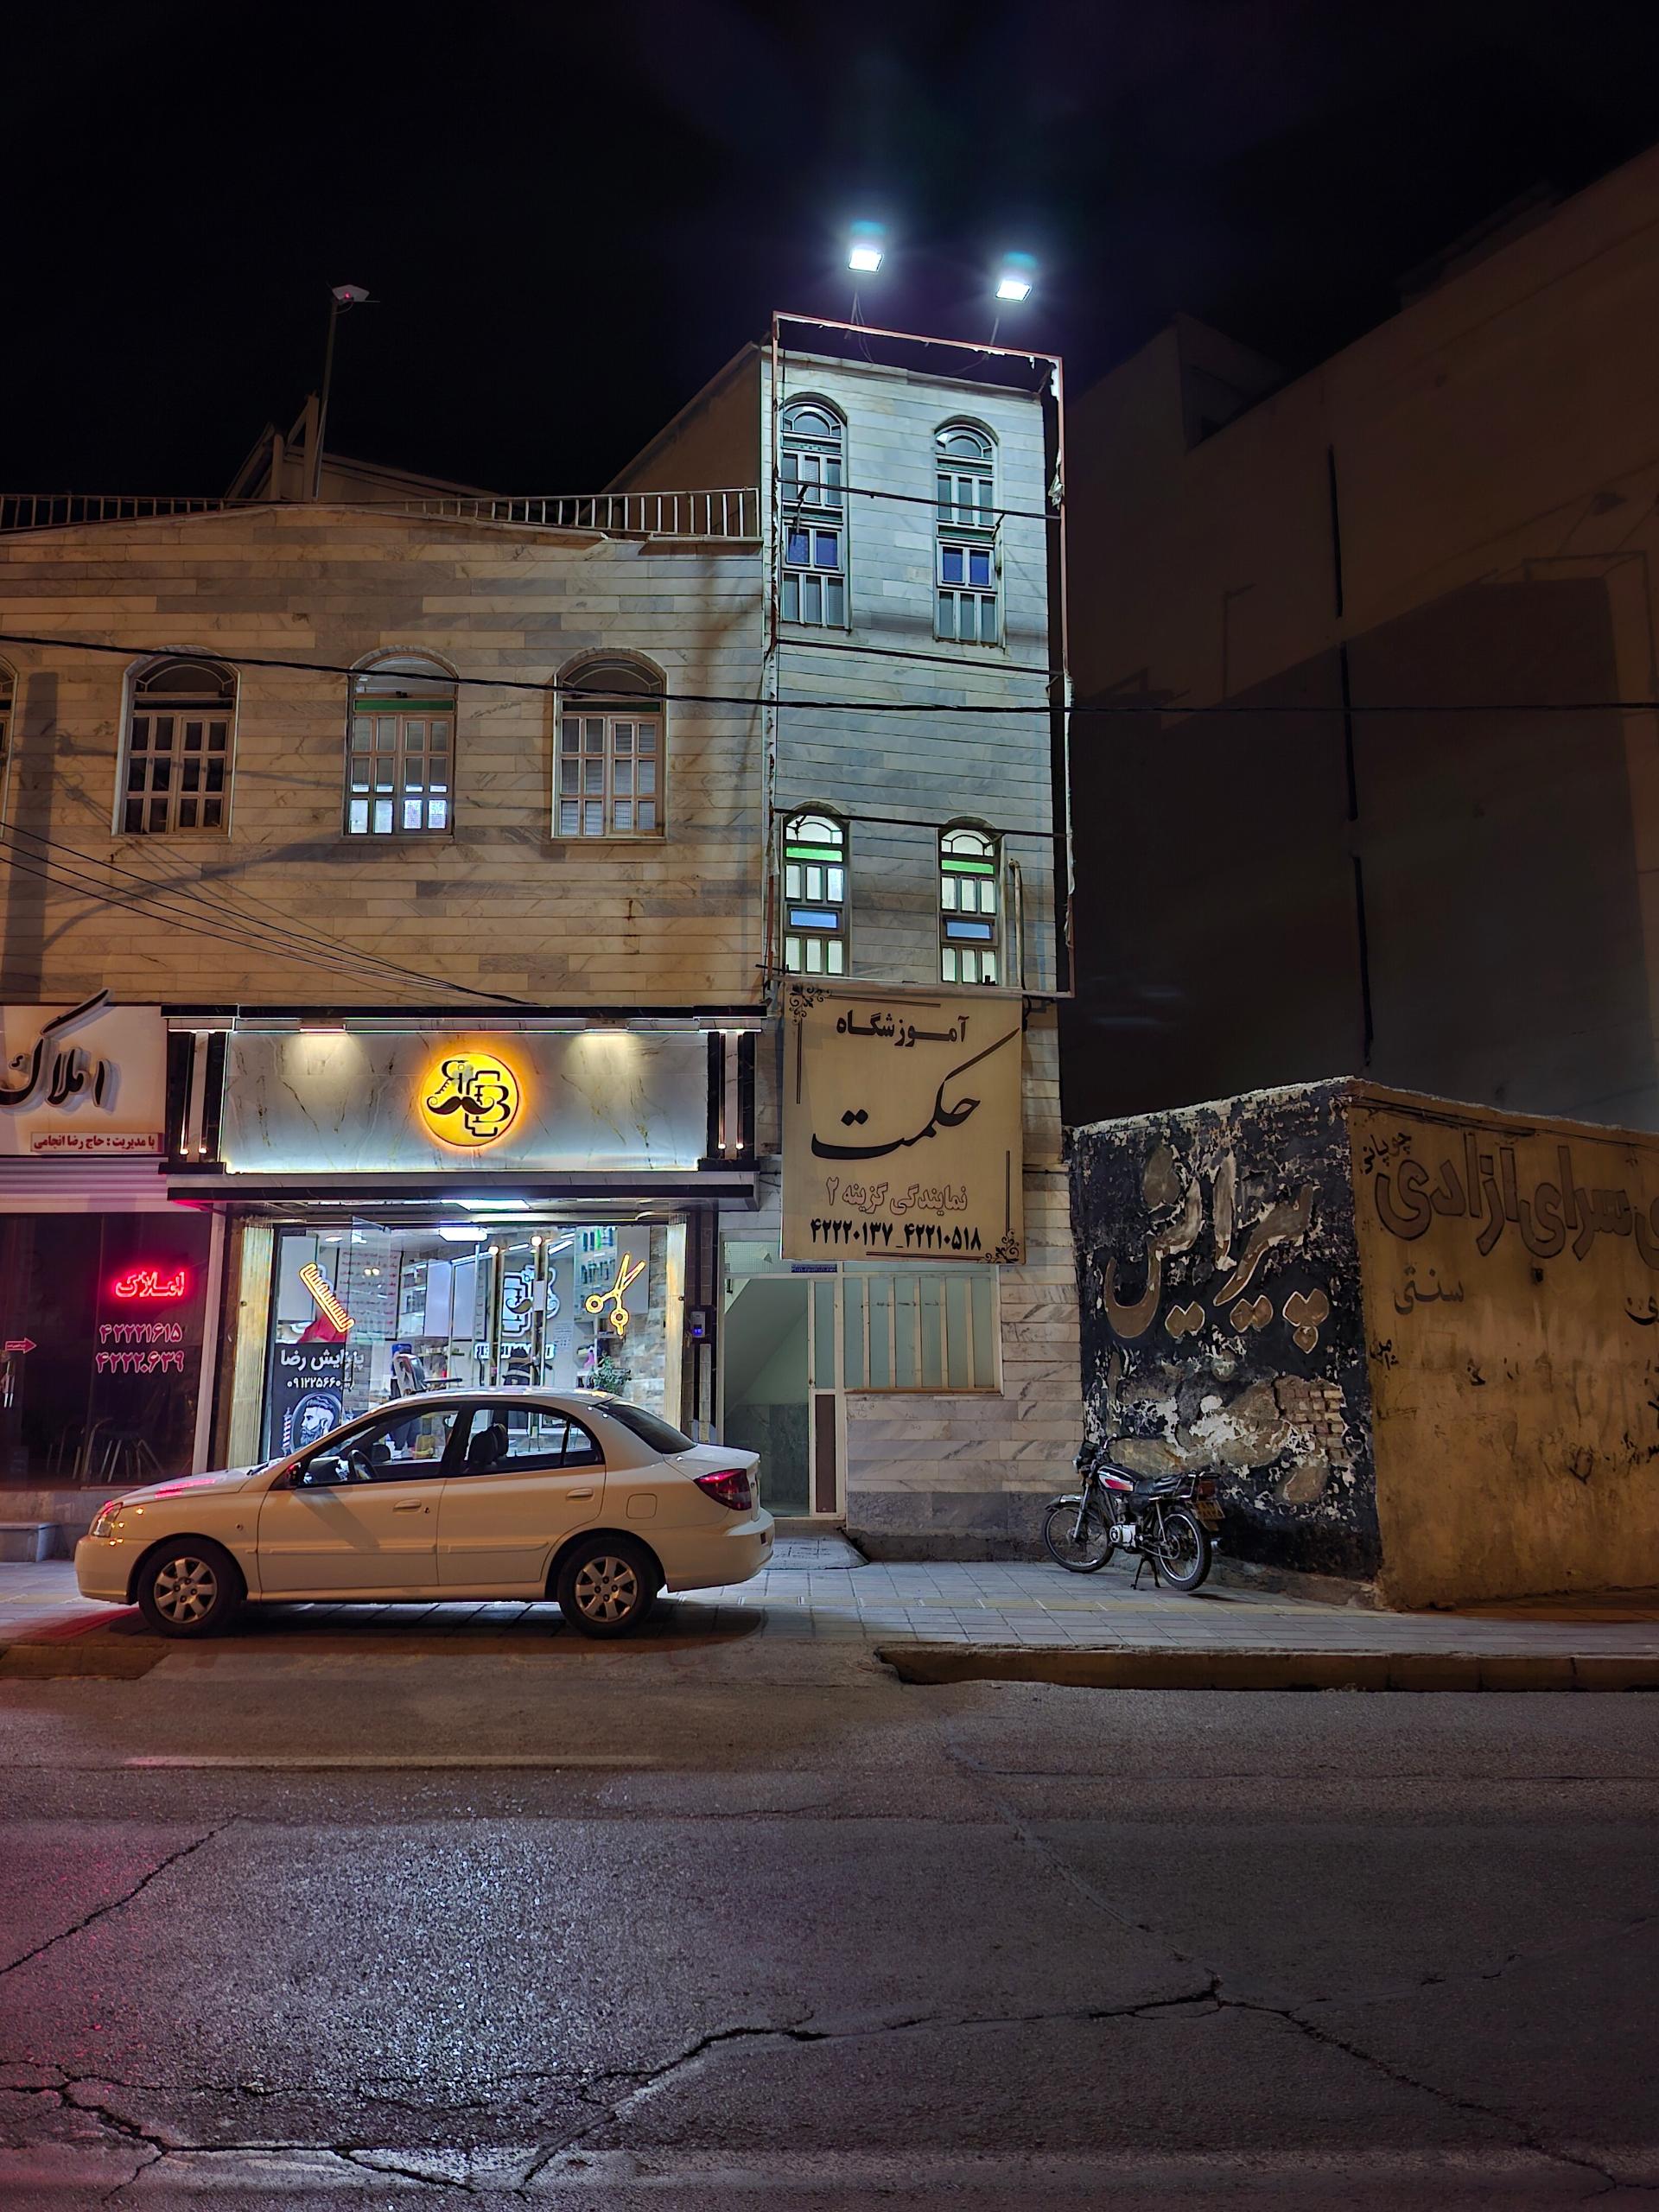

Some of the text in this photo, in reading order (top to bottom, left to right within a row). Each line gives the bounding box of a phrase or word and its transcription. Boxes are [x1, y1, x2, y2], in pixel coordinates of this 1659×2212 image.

[836, 1009, 970, 1047] آموزشگاه
[810, 1027, 1020, 1160] حکمت
[67, 1135, 84, 1150] رضا
[86, 1135, 105, 1149] حاج
[111, 1137, 146, 1150] مدیریت
[148, 1135, 156, 1149] با
[825, 1176, 968, 1217] نمایندگی گزینه ۲
[1519, 1145, 1634, 1262] سرای
[115, 1270, 186, 1298] املاک
[1393, 1266, 1465, 1315] سنتی
[99, 1322, 183, 1344] ۴۲۲۲۱۶۱۵
[95, 1351, 185, 1374] ۴۲۲۲۰۶۳۹
[280, 1349, 307, 1372] رضا
